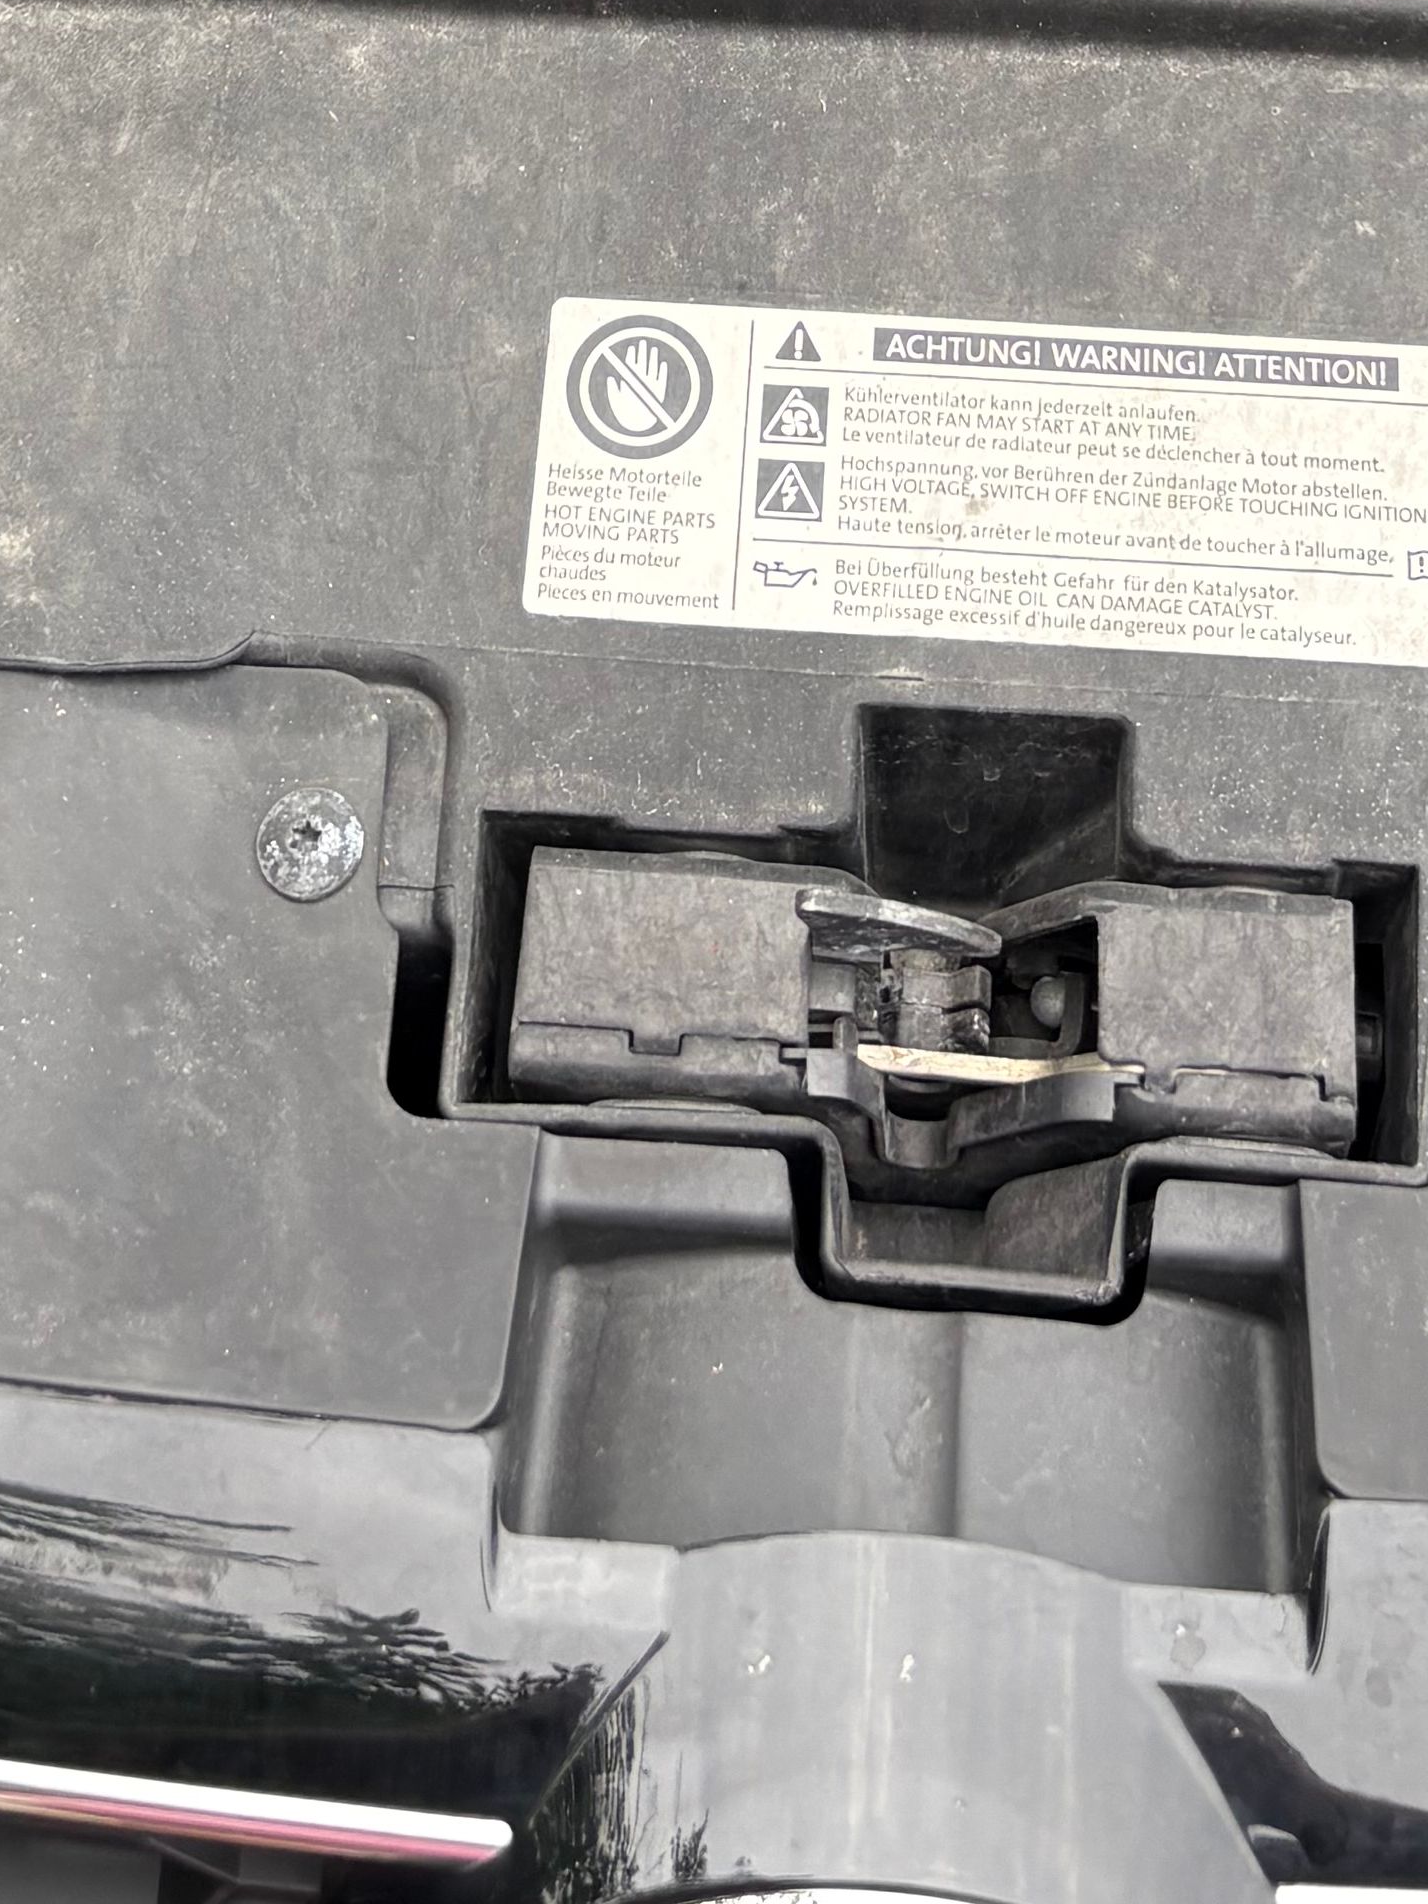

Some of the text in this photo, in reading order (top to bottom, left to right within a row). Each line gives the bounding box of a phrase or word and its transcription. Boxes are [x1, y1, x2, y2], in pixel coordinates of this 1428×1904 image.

[885, 333, 1386, 385] ACHTUNG! WARNING! ATTENTION!
[845, 385, 985, 409] Kühlerventilator
[990, 393, 1032, 412] kann
[1037, 396, 1111, 421] jederzeit
[843, 406, 930, 425] RADIATOR
[937, 412, 970, 428] FAN
[976, 414, 1017, 430] MAY
[1022, 416, 1073, 434] START
[1079, 420, 1099, 435] AT
[1105, 421, 1141, 437] ANY
[842, 426, 1384, 472] Le ventilateur de radiateur peut se déclencher à tout moment.
[548, 462, 702, 487] Heisse Motorteile
[982, 465, 1008, 479] vor
[1014, 464, 1093, 484] Berühren
[1099, 469, 1127, 486] der
[1132, 471, 1236, 496] Zündanlage
[1242, 477, 1296, 495] Motor
[1301, 480, 1387, 501] abstellen.
[546, 480, 667, 504] Bewegte Teile
[838, 495, 913, 514] SYSTEM.
[839, 475, 1426, 523] HIGH VOLTAGE, SWITCH OFF ENGINE BEFORE TOUCHING IGNITION
[544, 503, 716, 528] HOT ENGINE PARTS
[542, 521, 679, 544] MOVING PARTS
[837, 514, 891, 533] Haute
[971, 522, 1030, 541] arrêter
[1035, 526, 1051, 542] le
[1055, 529, 1120, 546] moteur
[1125, 533, 1174, 549] avant
[1179, 534, 1201, 551] de
[1207, 536, 1274, 555] toucher
[1280, 540, 1288, 556] à
[538, 562, 606, 581] chaudes
[593, 547, 615, 564] du
[620, 549, 681, 568] moteur
[833, 579, 938, 600] OVERFILLED
[944, 586, 1012, 604] ENGINE
[1018, 590, 1047, 606] OIL
[1056, 592, 1094, 609] CAN
[1100, 595, 1182, 614] DAMAGE
[835, 557, 1298, 604] Bei Überfüllung besteht Gefahr für den Katalysator.
[591, 589, 612, 602] en
[617, 588, 719, 608] mouvement
[833, 599, 1356, 649] Remplissage excessif d'huile dangereux pour le catalyseur.
